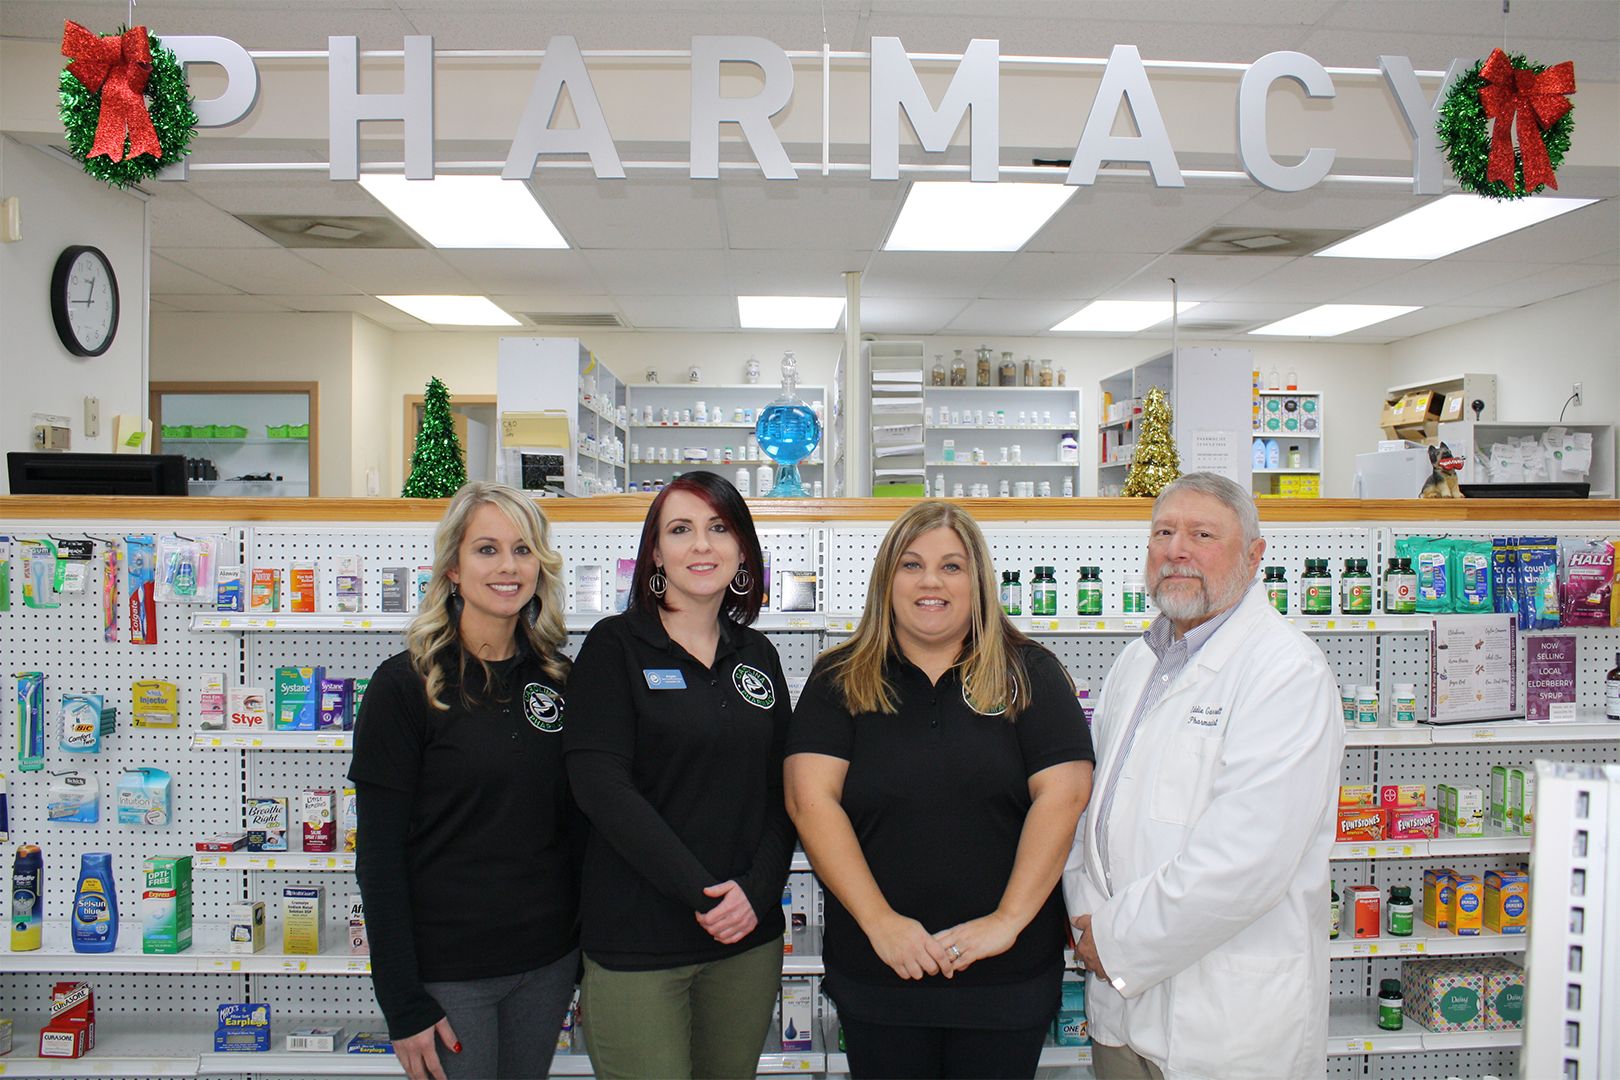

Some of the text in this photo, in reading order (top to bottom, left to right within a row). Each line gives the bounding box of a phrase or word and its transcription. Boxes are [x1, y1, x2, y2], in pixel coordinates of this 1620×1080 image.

[155, 35, 1470, 195] PHARMACY
[1570, 554, 1613, 566] HALLS
[1524, 562, 1549, 575] cough
[1539, 667, 1561, 675] LOCAL
[281, 682, 310, 695] Systane
[322, 682, 343, 692] Systane
[1528, 680, 1573, 688] ELDERBERRY
[140, 697, 168, 706] Injector
[231, 713, 263, 727] Stye
[68, 733, 91, 743] Comfort
[248, 805, 282, 816] Breathe
[253, 814, 279, 825] Right
[1341, 813, 1380, 832] FLINTSTONES
[1397, 813, 1434, 831] FLINTSTONES
[148, 870, 170, 879] OPTI-
[148, 877, 170, 886] FREE
[78, 900, 106, 908] Selsun
[83, 907, 101, 915] blue
[225, 1018, 268, 1027] Earplugs
[1063, 1025, 1079, 1033] ONE
